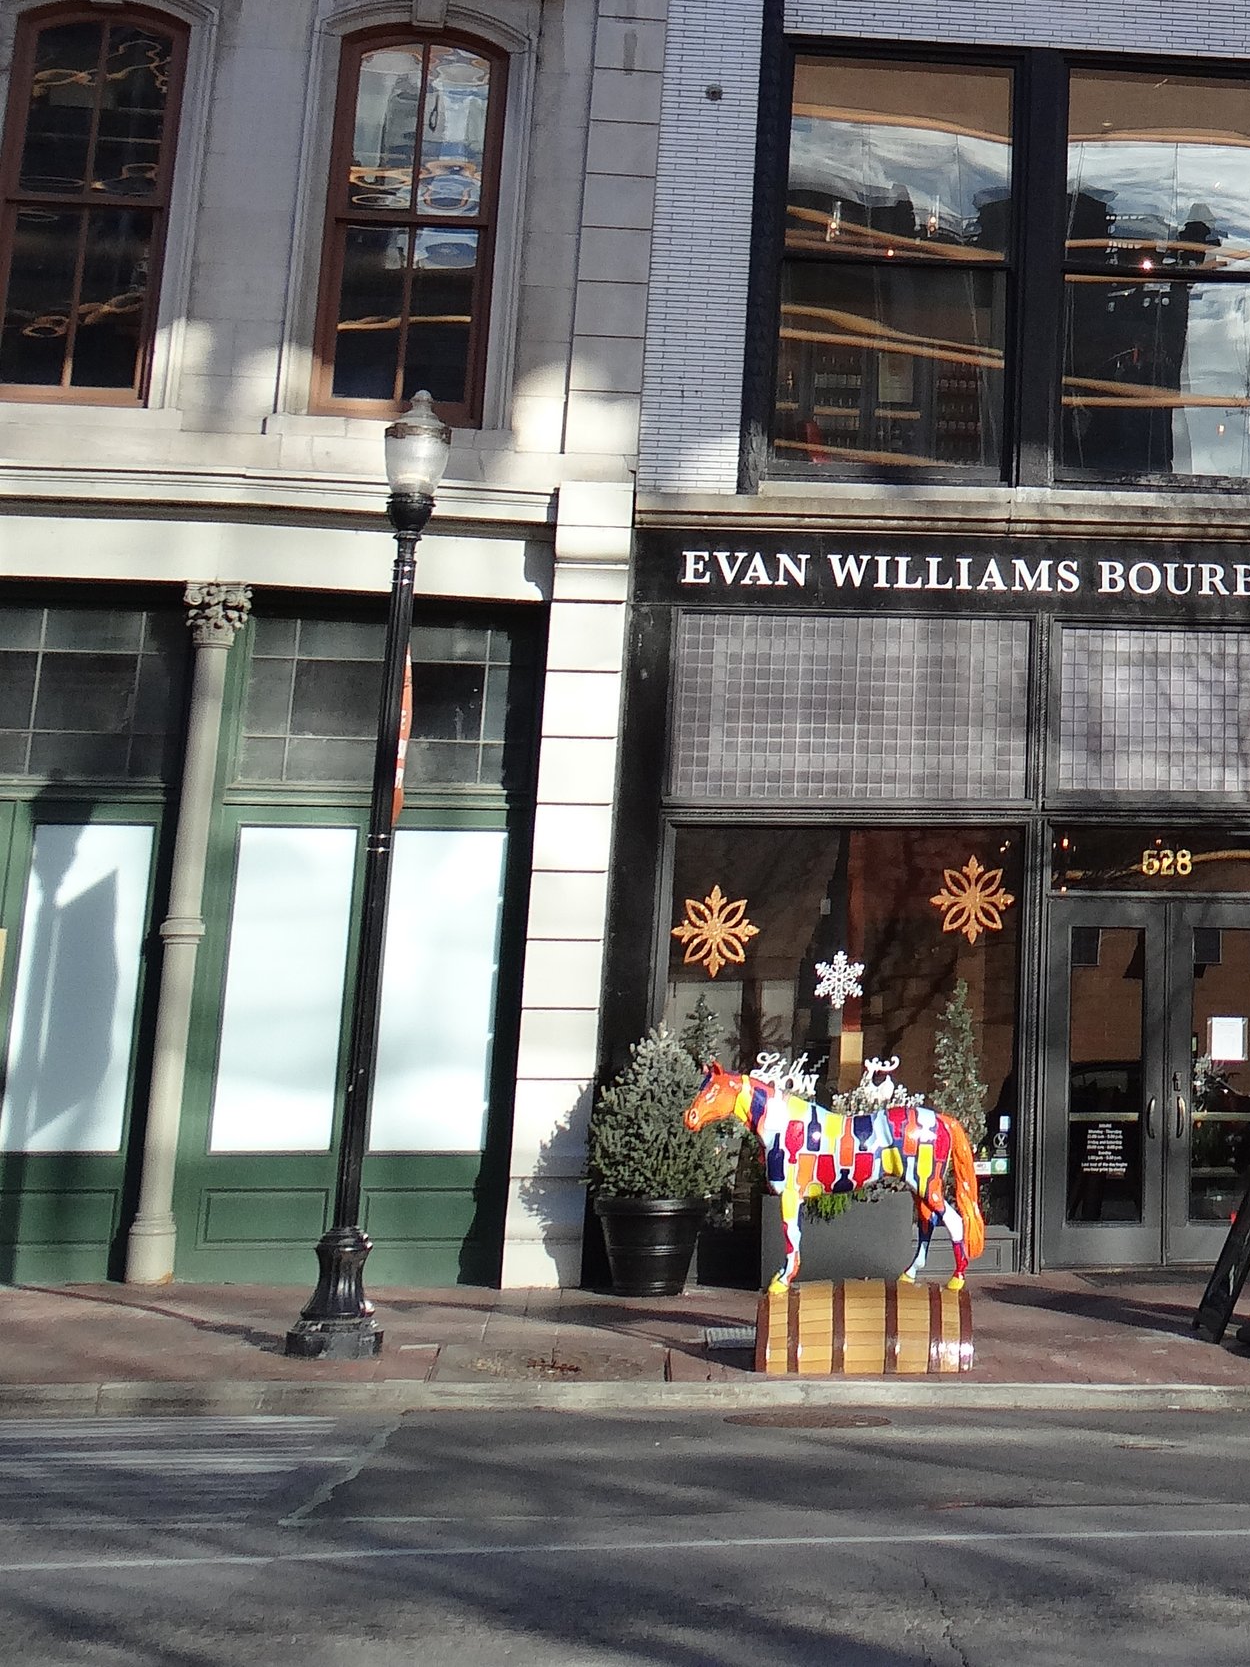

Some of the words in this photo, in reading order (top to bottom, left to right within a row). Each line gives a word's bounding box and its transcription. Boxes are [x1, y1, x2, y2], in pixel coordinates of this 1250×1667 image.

[681, 550, 810, 586] EVAN
[827, 554, 1080, 593] WILLIAMS
[1142, 849, 1192, 875] 528
